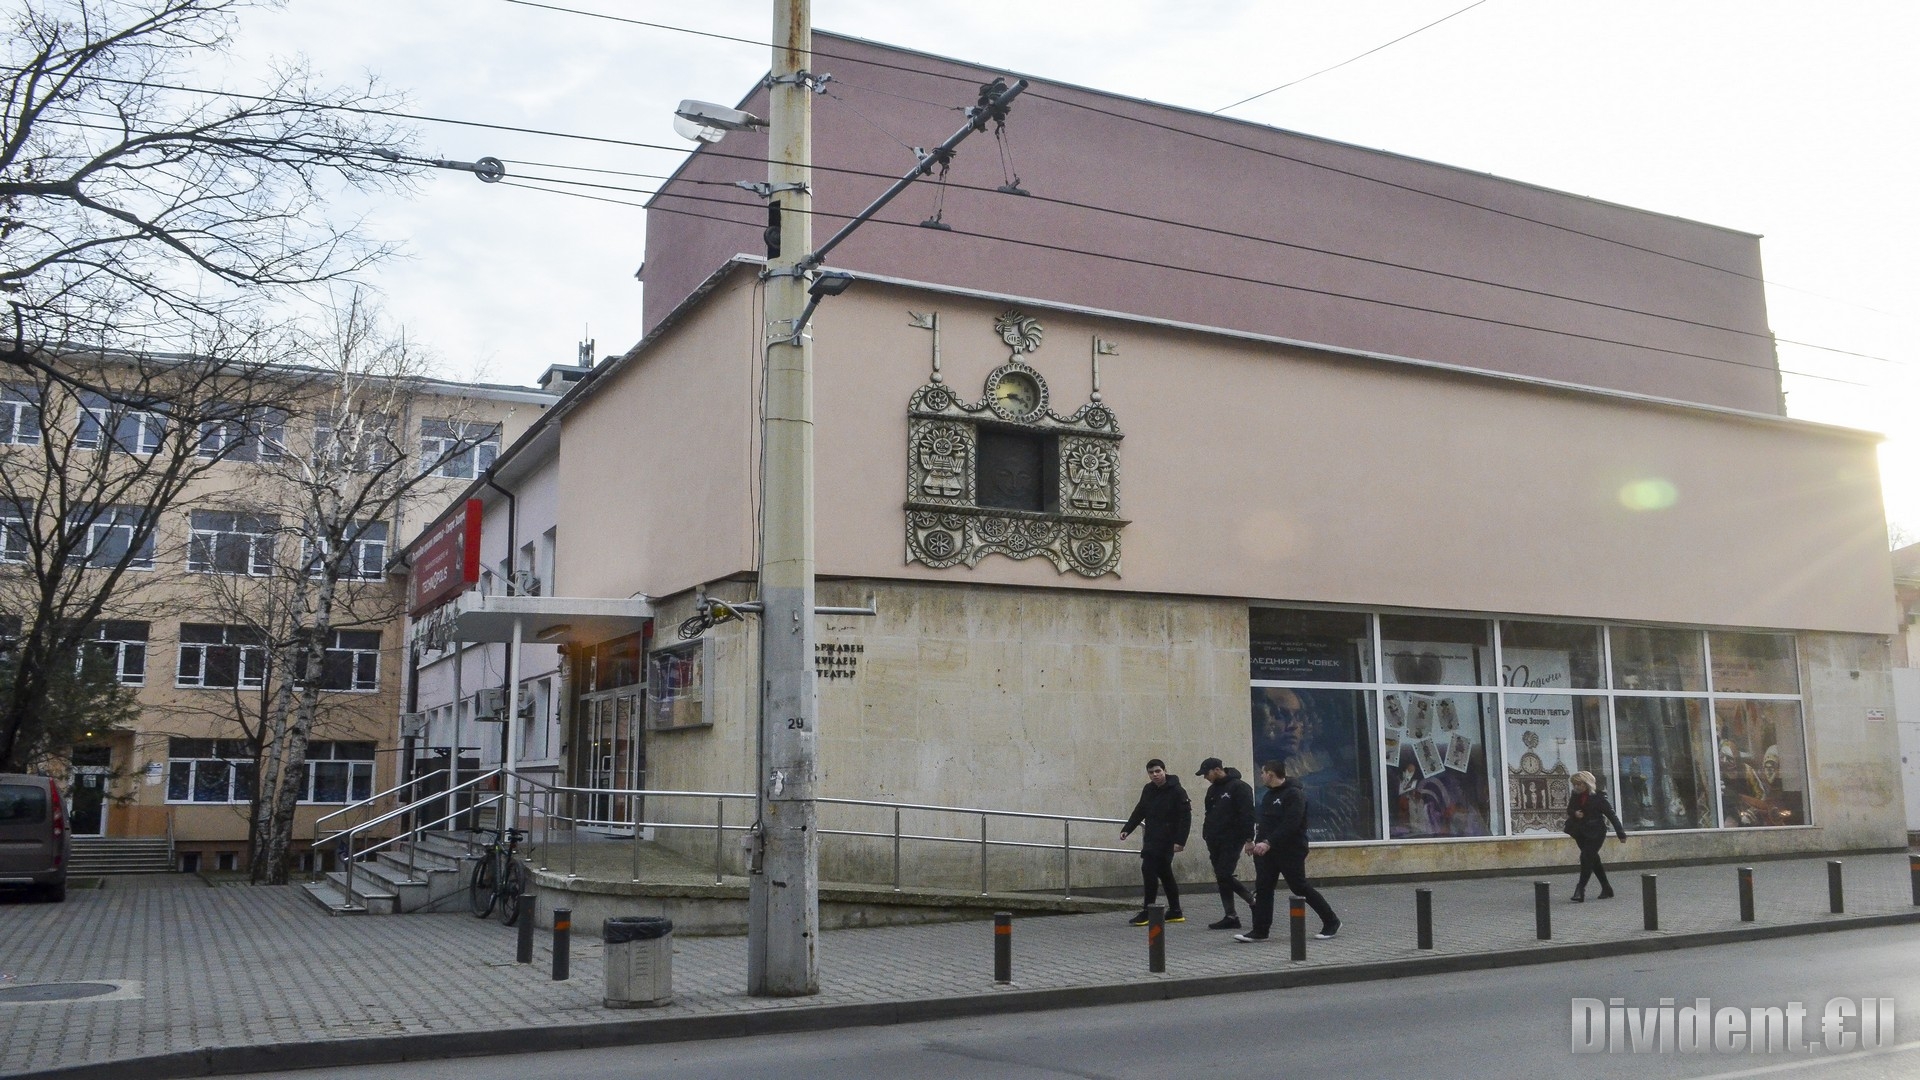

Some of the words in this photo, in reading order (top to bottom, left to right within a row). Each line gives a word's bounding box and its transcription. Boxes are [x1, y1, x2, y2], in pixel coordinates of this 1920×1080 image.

[815, 643, 864, 653] ЪРЖАВЕН
[1307, 659, 1340, 667] ЧОВЕК
[816, 669, 856, 679] ТЕАТЪР
[788, 718, 804, 730] 29
[1508, 716, 1528, 726] Стара
[1529, 717, 1550, 727] Загора
